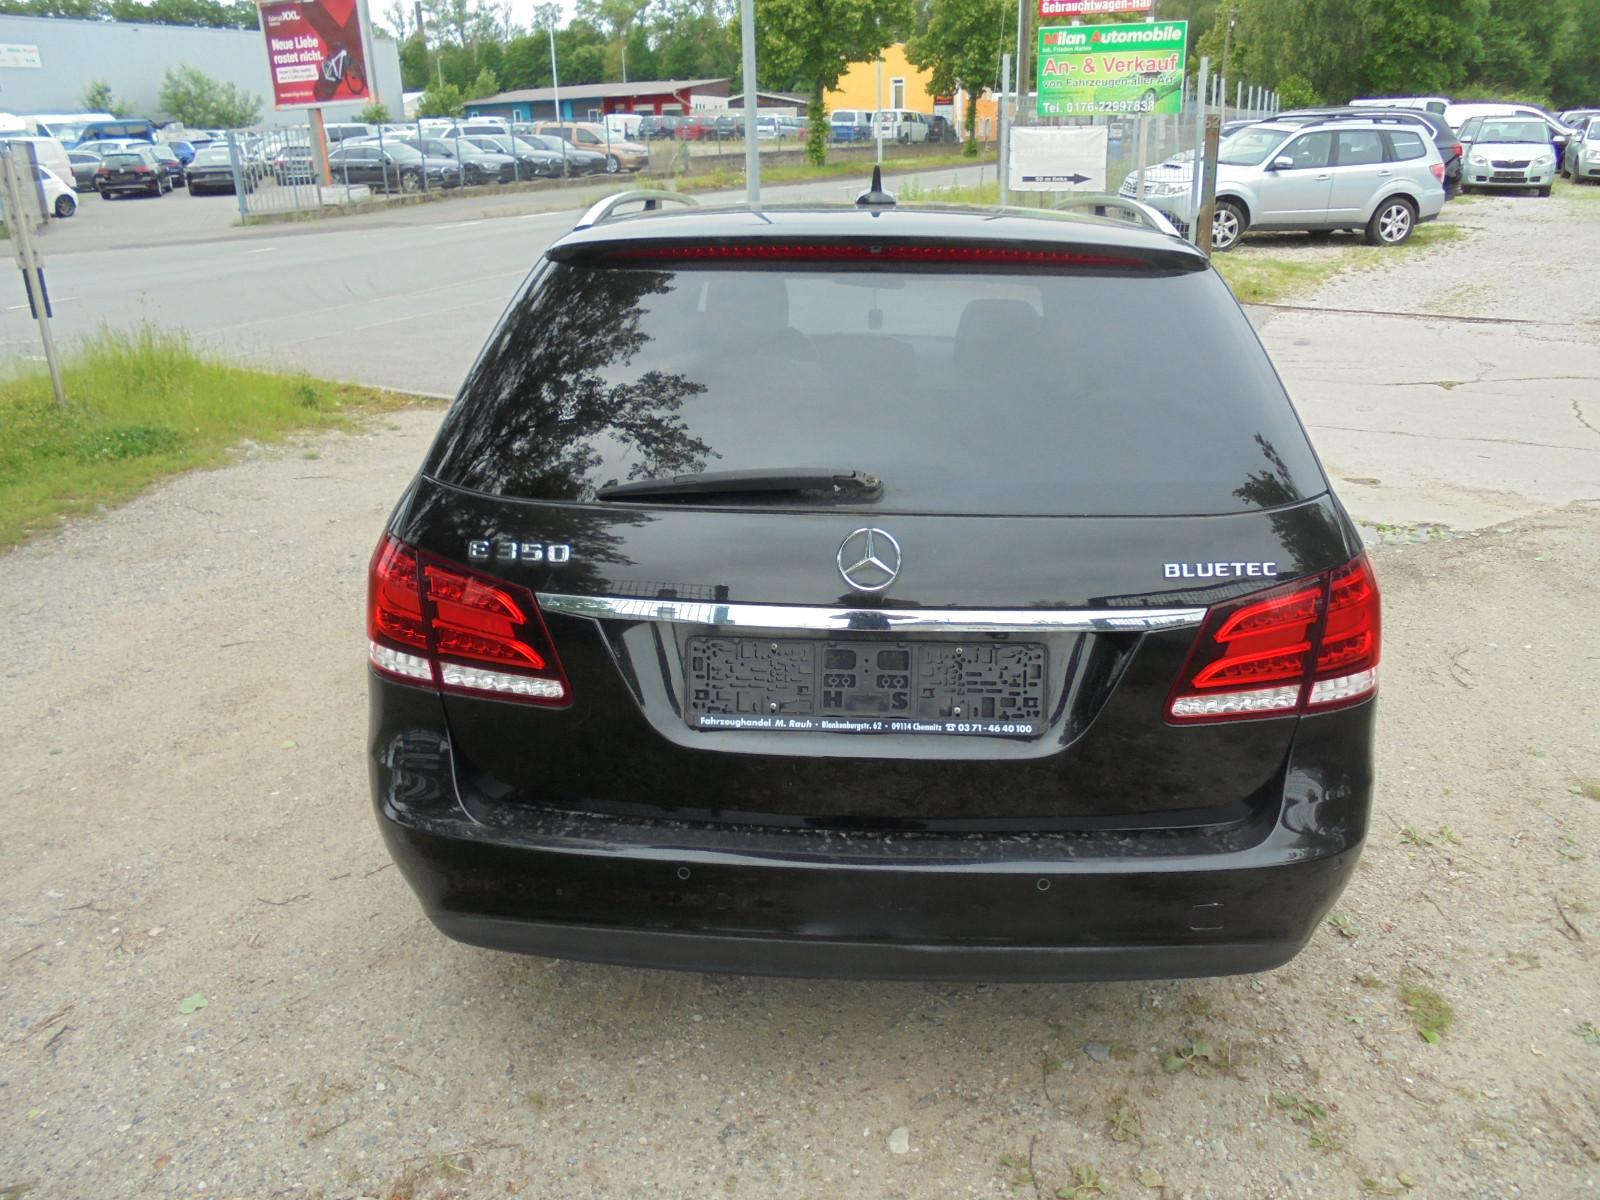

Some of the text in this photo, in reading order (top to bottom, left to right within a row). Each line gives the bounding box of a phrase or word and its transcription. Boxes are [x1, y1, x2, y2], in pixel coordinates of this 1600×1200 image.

[272, 36, 319, 51] Neue Liebe
[1043, 26, 1182, 46] Milan Automobile
[274, 50, 324, 65] rostet nicht.
[1042, 52, 1180, 76] An- & Verkauf
[1042, 79, 1063, 89] von
[1066, 76, 1128, 89] Fahrzeugen
[1130, 75, 1154, 86] aller
[1042, 102, 1063, 113] Tel.
[468, 540, 570, 563] E 350
[1163, 562, 1277, 578] BLUETEC
[700, 716, 772, 728] Fahrzeughandel
[775, 719, 787, 728] M.
[789, 719, 812, 729] Rauh
[873, 722, 882, 730] 62
[891, 722, 912, 731] 09114
[912, 723, 942, 731] Chemnitz
